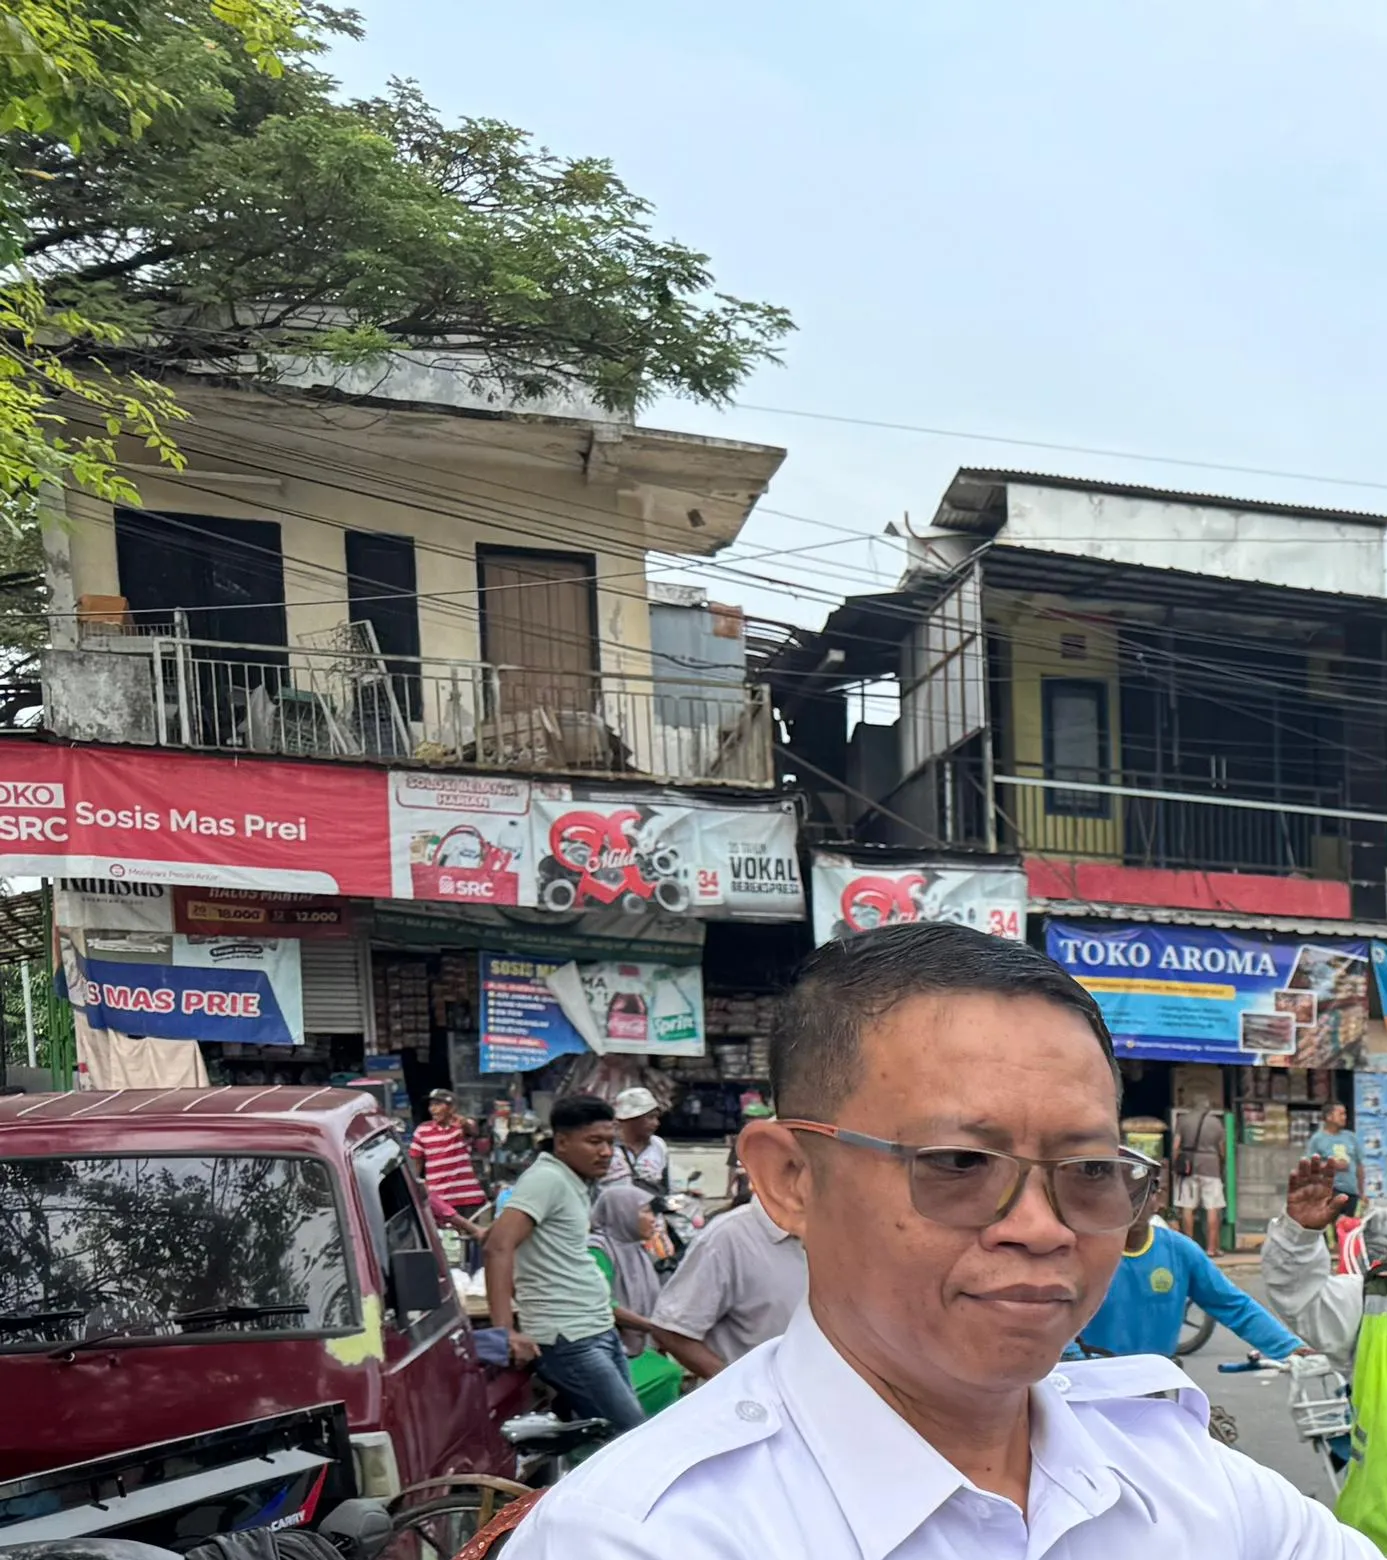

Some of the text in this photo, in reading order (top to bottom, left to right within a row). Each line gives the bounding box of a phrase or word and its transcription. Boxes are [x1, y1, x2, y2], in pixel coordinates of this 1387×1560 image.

[0, 815, 69, 842] SRC
[75, 801, 307, 841] Sosis Mas Prei
[697, 869, 718, 889] 34
[729, 856, 799, 882] VOKAL
[456, 880, 495, 896] SRC
[1058, 938, 1279, 977] TOKO AROMA
[105, 985, 176, 1014] MAS
[181, 989, 261, 1018] PRIE
[271, 1509, 306, 1531] CARRY
